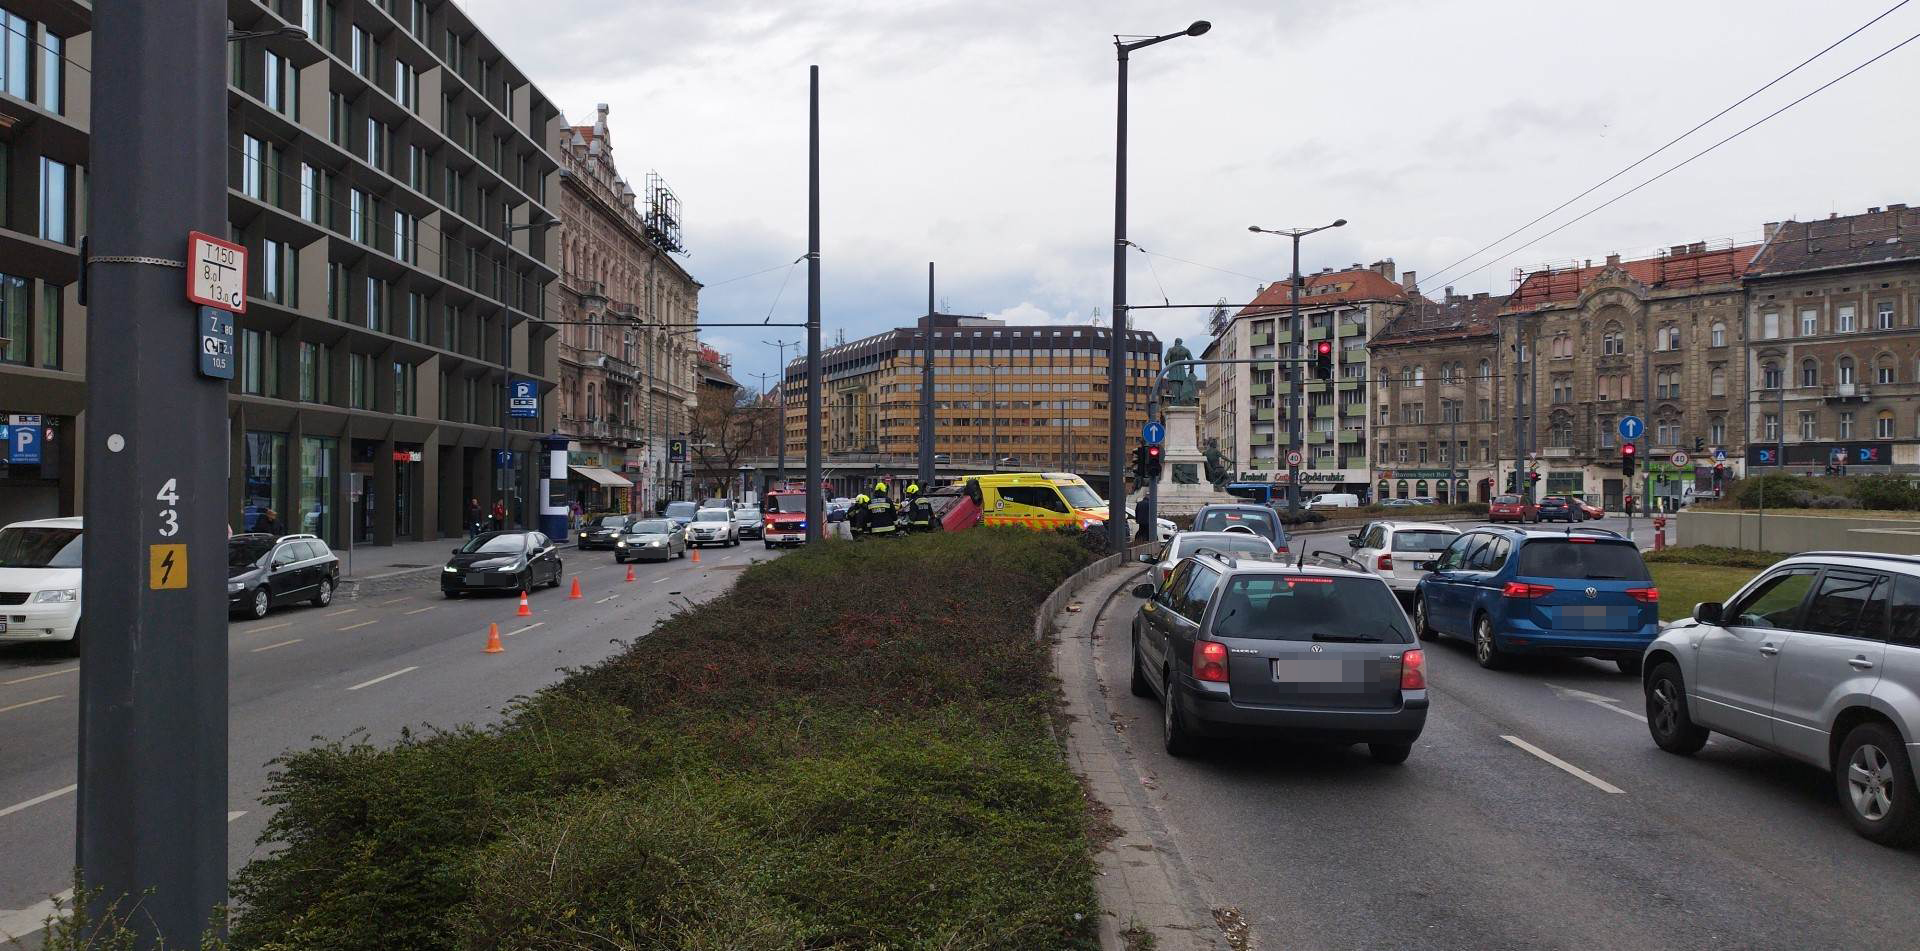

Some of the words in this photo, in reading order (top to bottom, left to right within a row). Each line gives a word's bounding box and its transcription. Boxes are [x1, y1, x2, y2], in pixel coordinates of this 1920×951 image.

[210, 316, 218, 332] Z
[17, 431, 33, 453] P
[1675, 455, 1685, 463] 40
